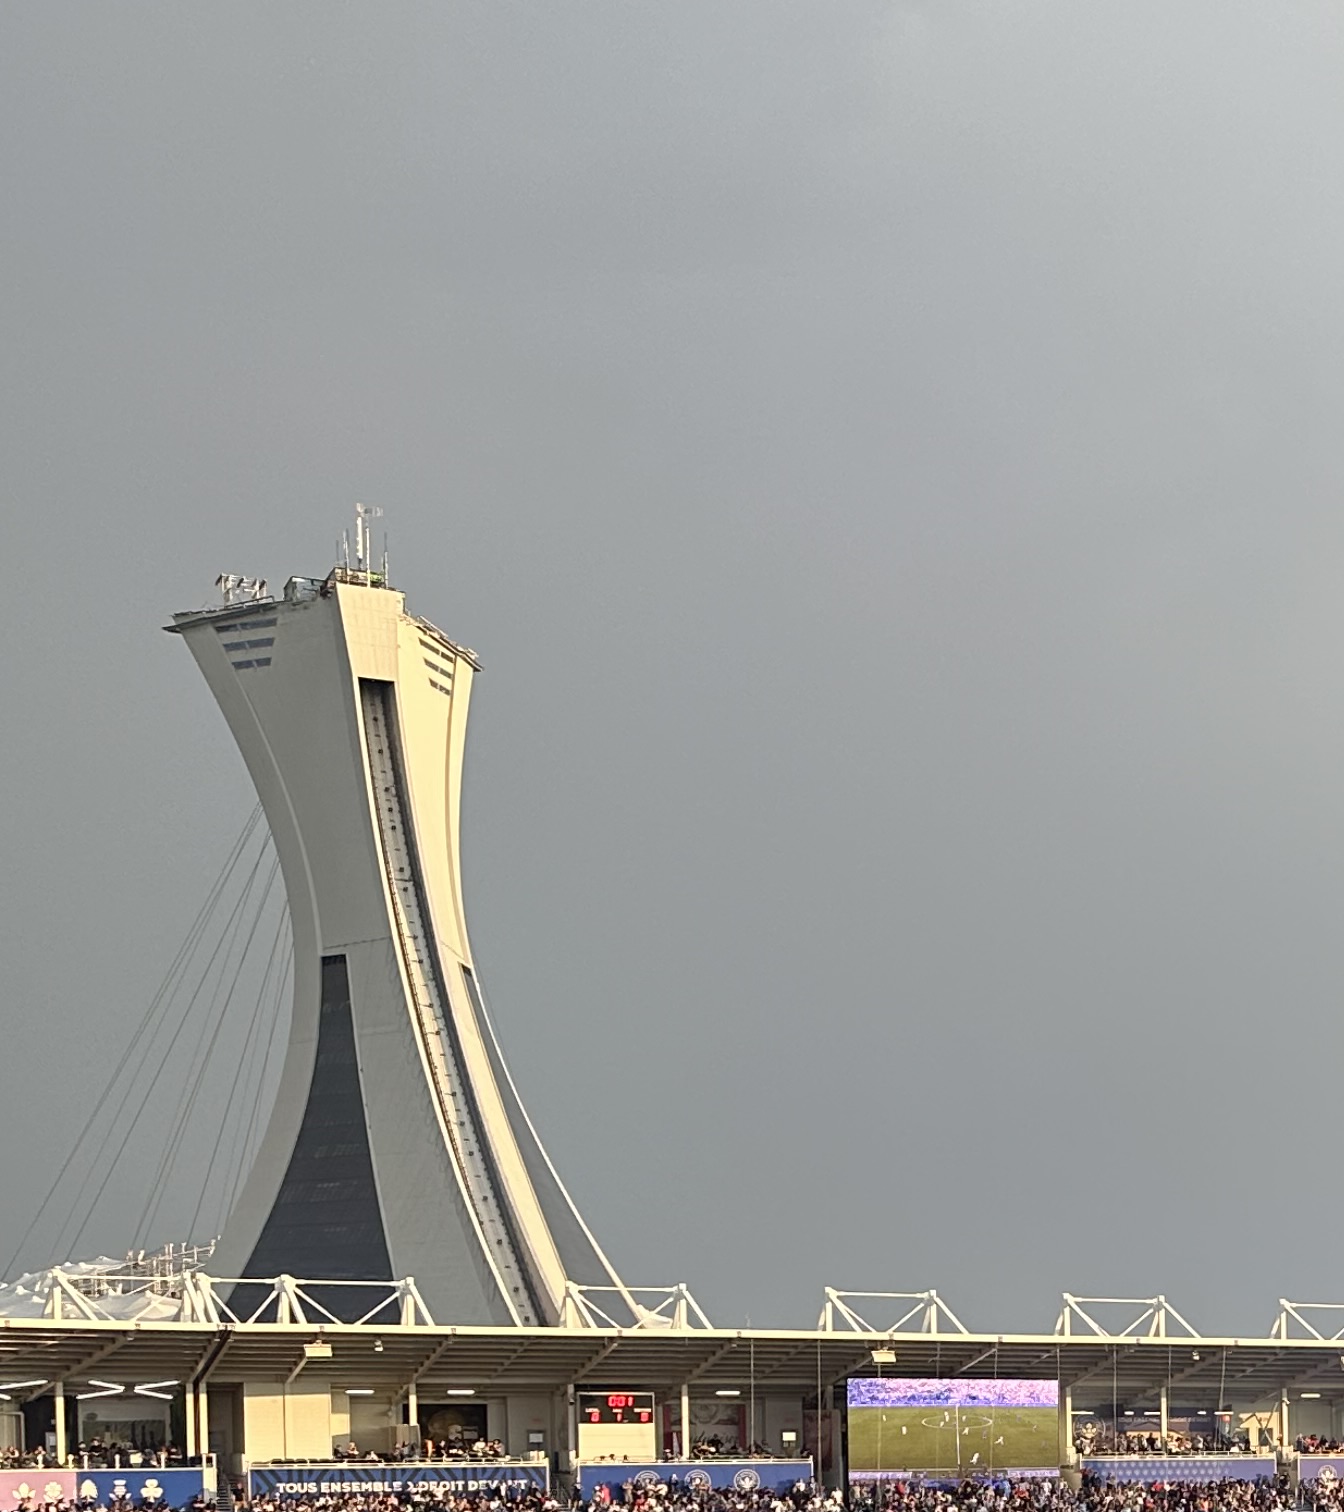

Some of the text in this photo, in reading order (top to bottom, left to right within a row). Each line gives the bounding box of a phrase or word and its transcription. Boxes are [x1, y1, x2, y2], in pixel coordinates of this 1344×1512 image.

[276, 1482, 317, 1493] TOUS
[320, 1480, 402, 1493] ENSEMBLE
[418, 1480, 465, 1493] DROIT
